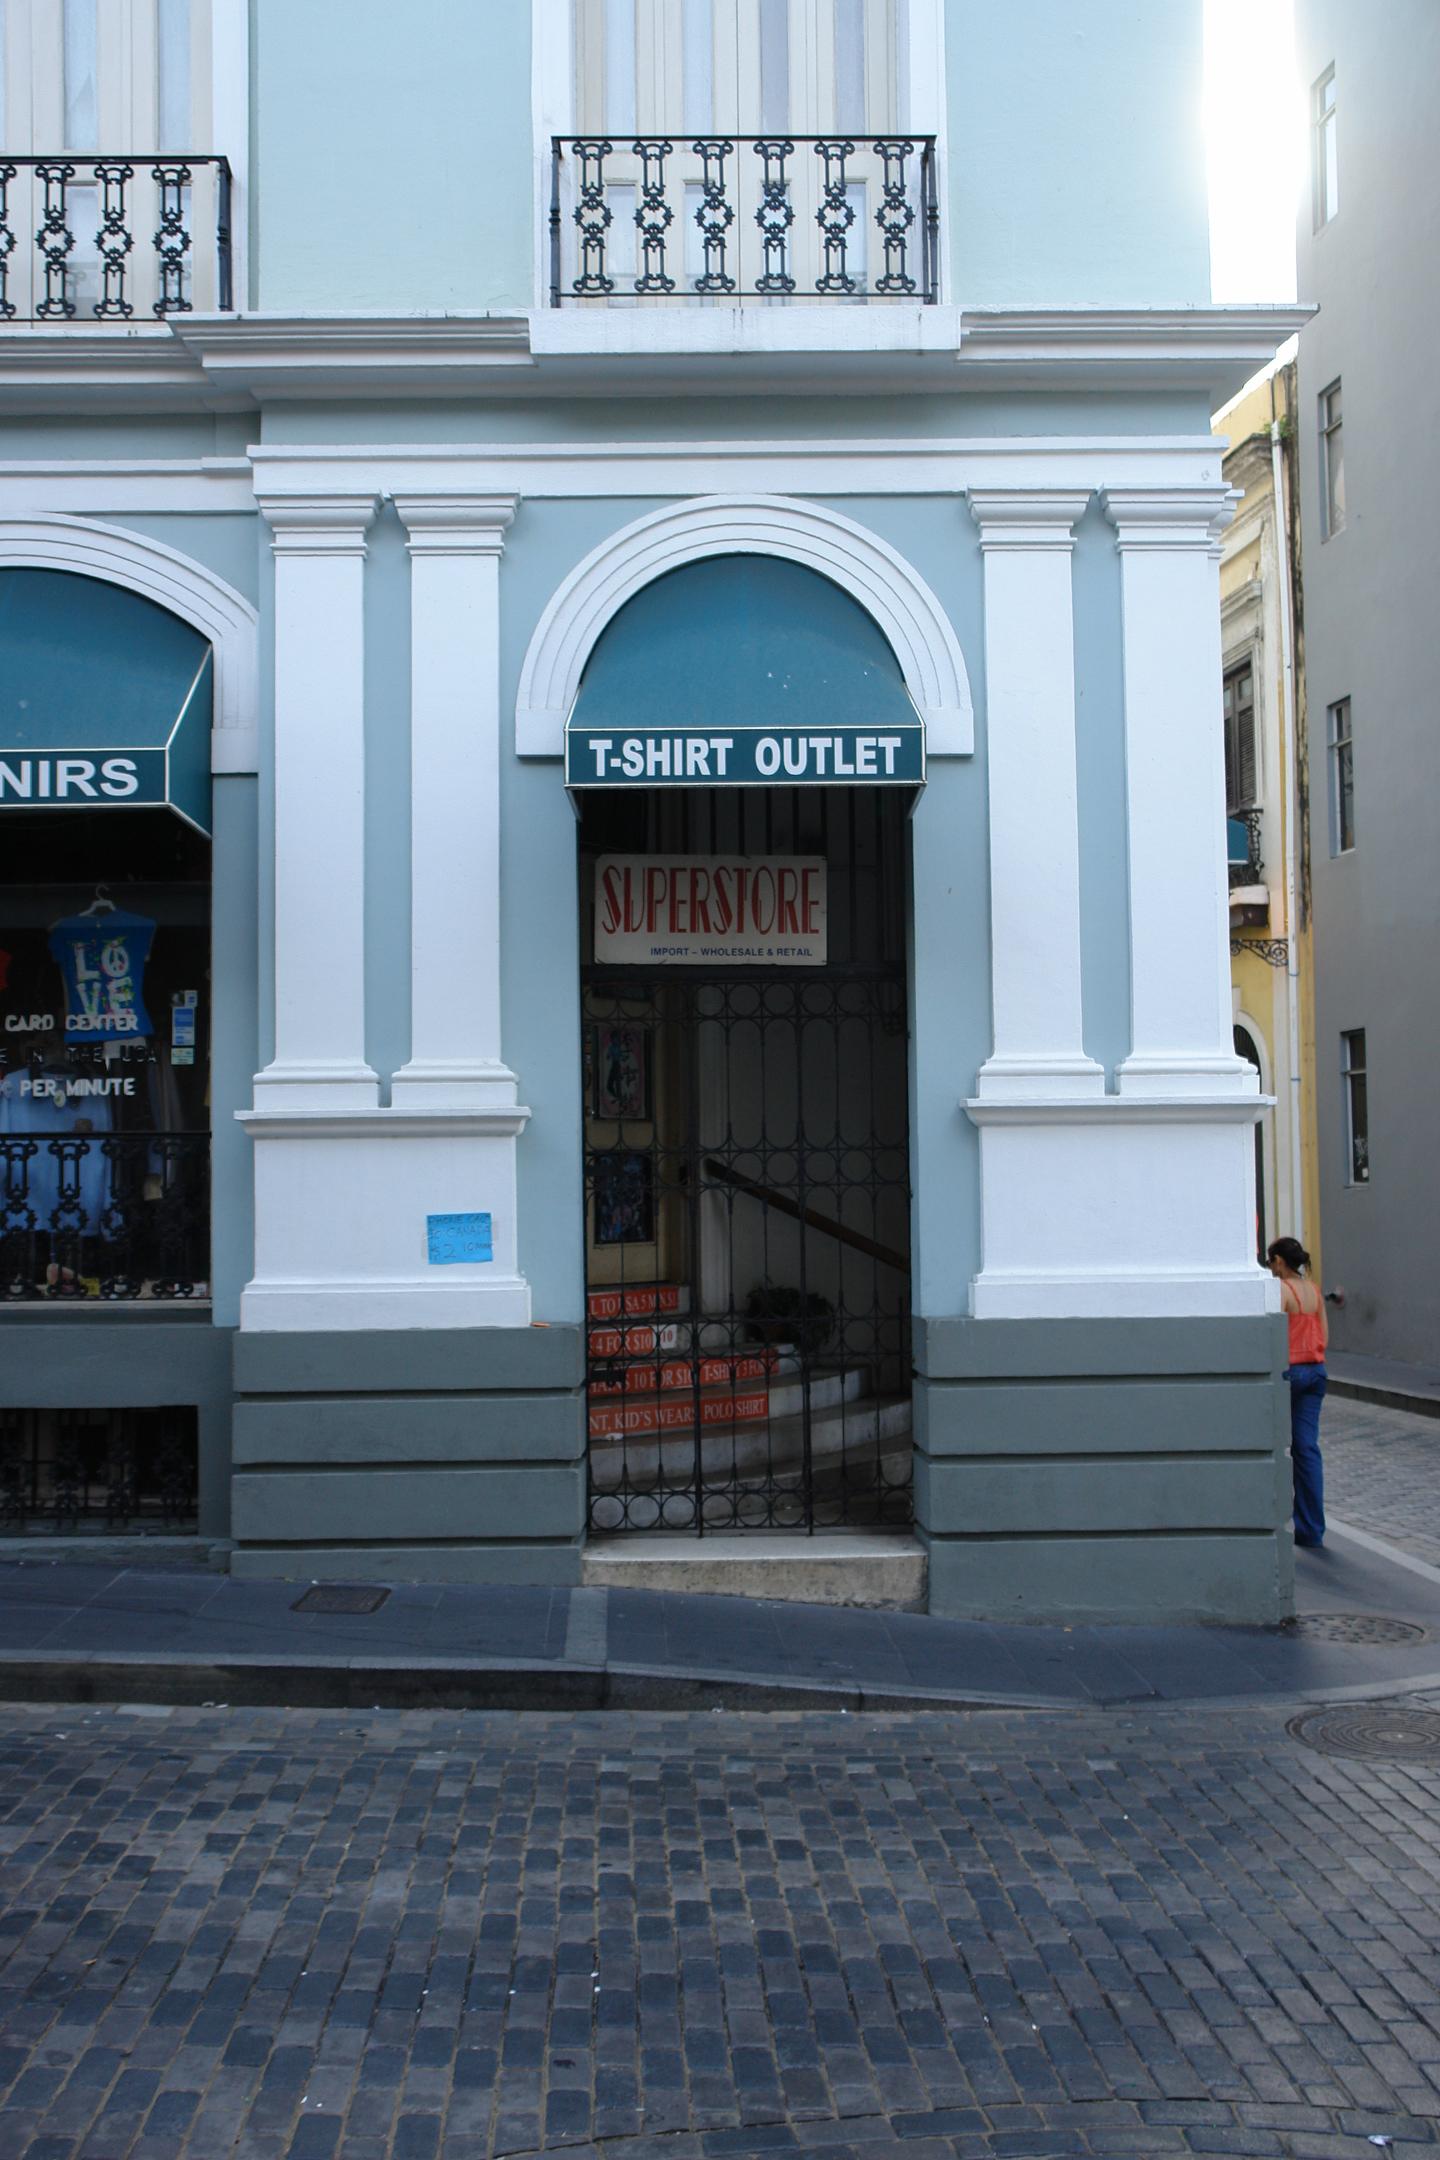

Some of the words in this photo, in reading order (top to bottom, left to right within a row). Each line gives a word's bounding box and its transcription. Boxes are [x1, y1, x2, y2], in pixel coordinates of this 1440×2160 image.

[589, 738, 733, 777] T-SHIRT
[755, 737, 901, 776] OUTLET
[601, 865, 820, 935] SUPERSTORE
[650, 947, 689, 957] IMPORT
[700, 947, 764, 957] WHOLESALE
[767, 947, 774, 957] &
[776, 947, 813, 957] RETAIL
[5, 1014, 55, 1032] CARD
[65, 1014, 139, 1032] CENTER
[20, 1079, 57, 1098] PER
[66, 1078, 137, 1097] MINUTE
[600, 1298, 616, 1314] TO
[596, 1337, 603, 1352] 4
[606, 1335, 632, 1352] FOR
[634, 1371, 647, 1388] 10
[649, 1370, 673, 1387] FOR
[703, 1361, 740, 1381] T-SHIT
[704, 1401, 734, 1420] POLO
[736, 1398, 765, 1416] SHIRT
[614, 1410, 652, 1429] KID'S
